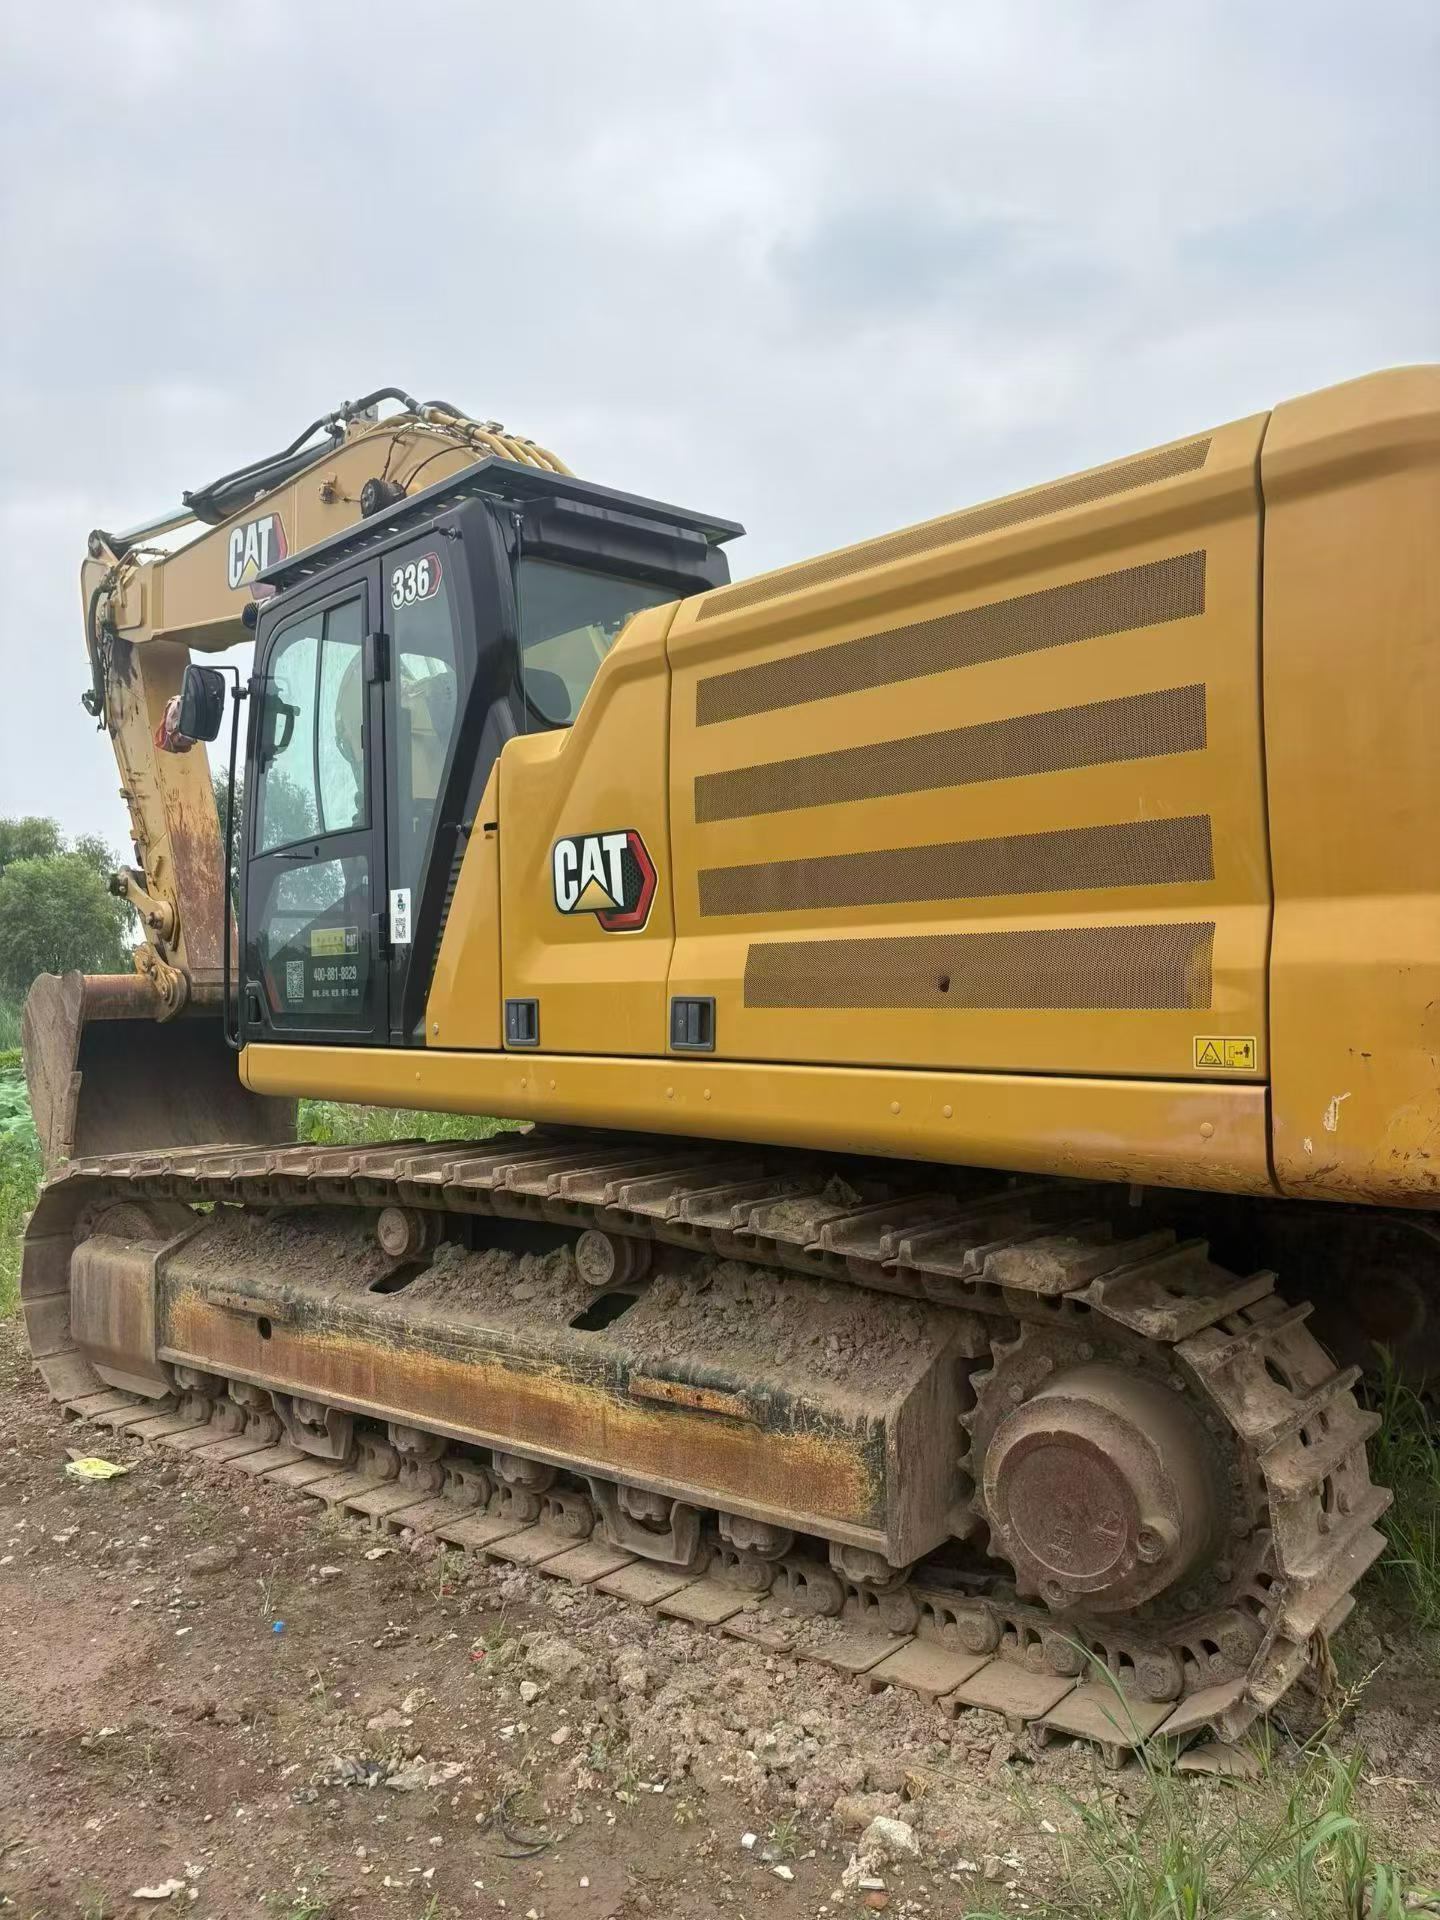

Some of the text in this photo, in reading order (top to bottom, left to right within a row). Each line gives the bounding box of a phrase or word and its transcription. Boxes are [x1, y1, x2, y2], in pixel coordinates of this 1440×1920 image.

[229, 516, 273, 588] CAT
[393, 558, 429, 606] 336
[554, 833, 628, 911] CAT
[313, 966, 357, 981] 400-881-8829
